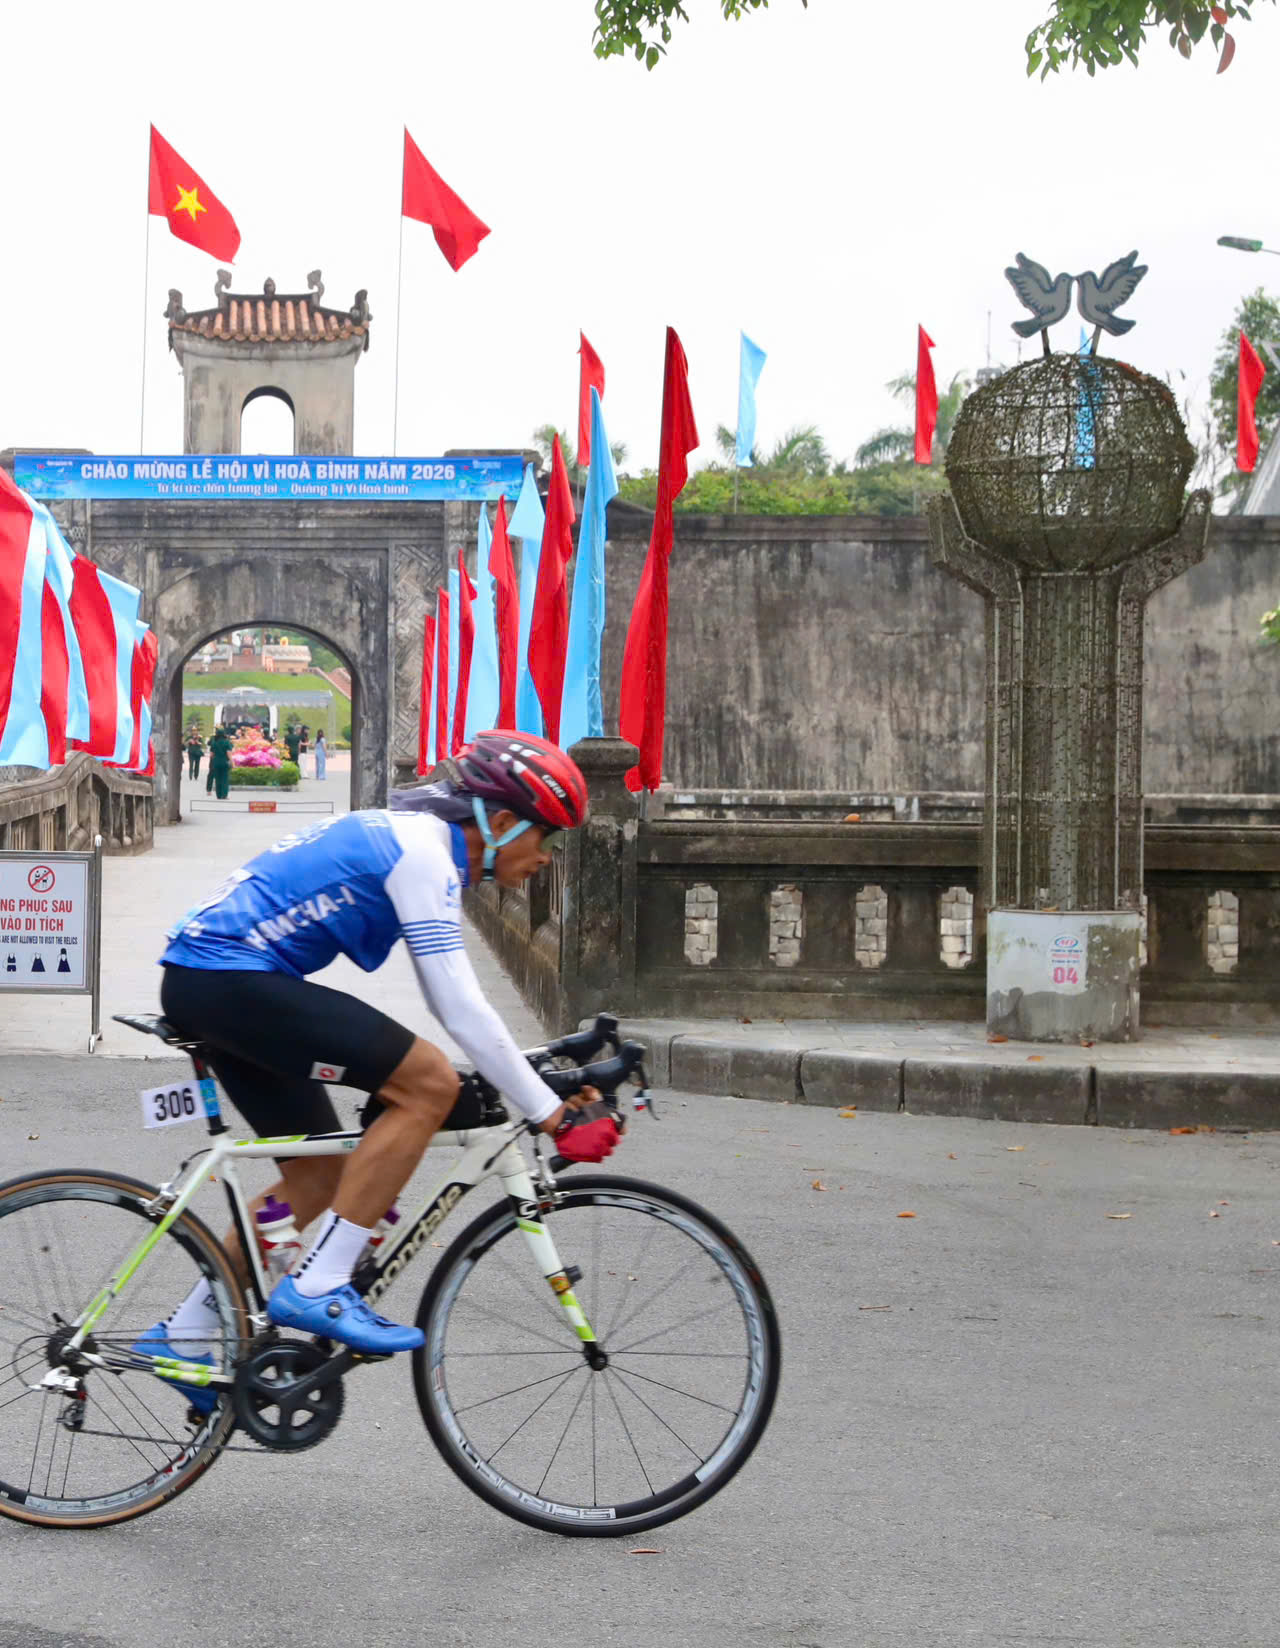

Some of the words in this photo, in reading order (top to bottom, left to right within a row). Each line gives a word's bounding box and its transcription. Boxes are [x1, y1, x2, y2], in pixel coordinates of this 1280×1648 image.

[81, 460, 129, 480] CHÀO
[134, 460, 188, 480] MỪNG
[192, 458, 213, 480] LỄ
[218, 460, 248, 483] HỘI
[252, 460, 270, 480] VÌ
[275, 460, 311, 480] HOÀ
[316, 460, 360, 480] BÌNH
[364, 461, 407, 480] NĂM
[411, 464, 456, 481] 2026
[19, 899, 48, 915] PHỤC
[52, 900, 73, 913] SAU
[0, 915, 22, 931] VÀO
[25, 918, 36, 931] DI
[39, 916, 64, 932] TÍCH
[1, 935, 10, 944] ARE
[19, 935, 38, 945] ALLOWED
[1053, 967, 1079, 985] 04
[154, 1087, 195, 1121] 306
